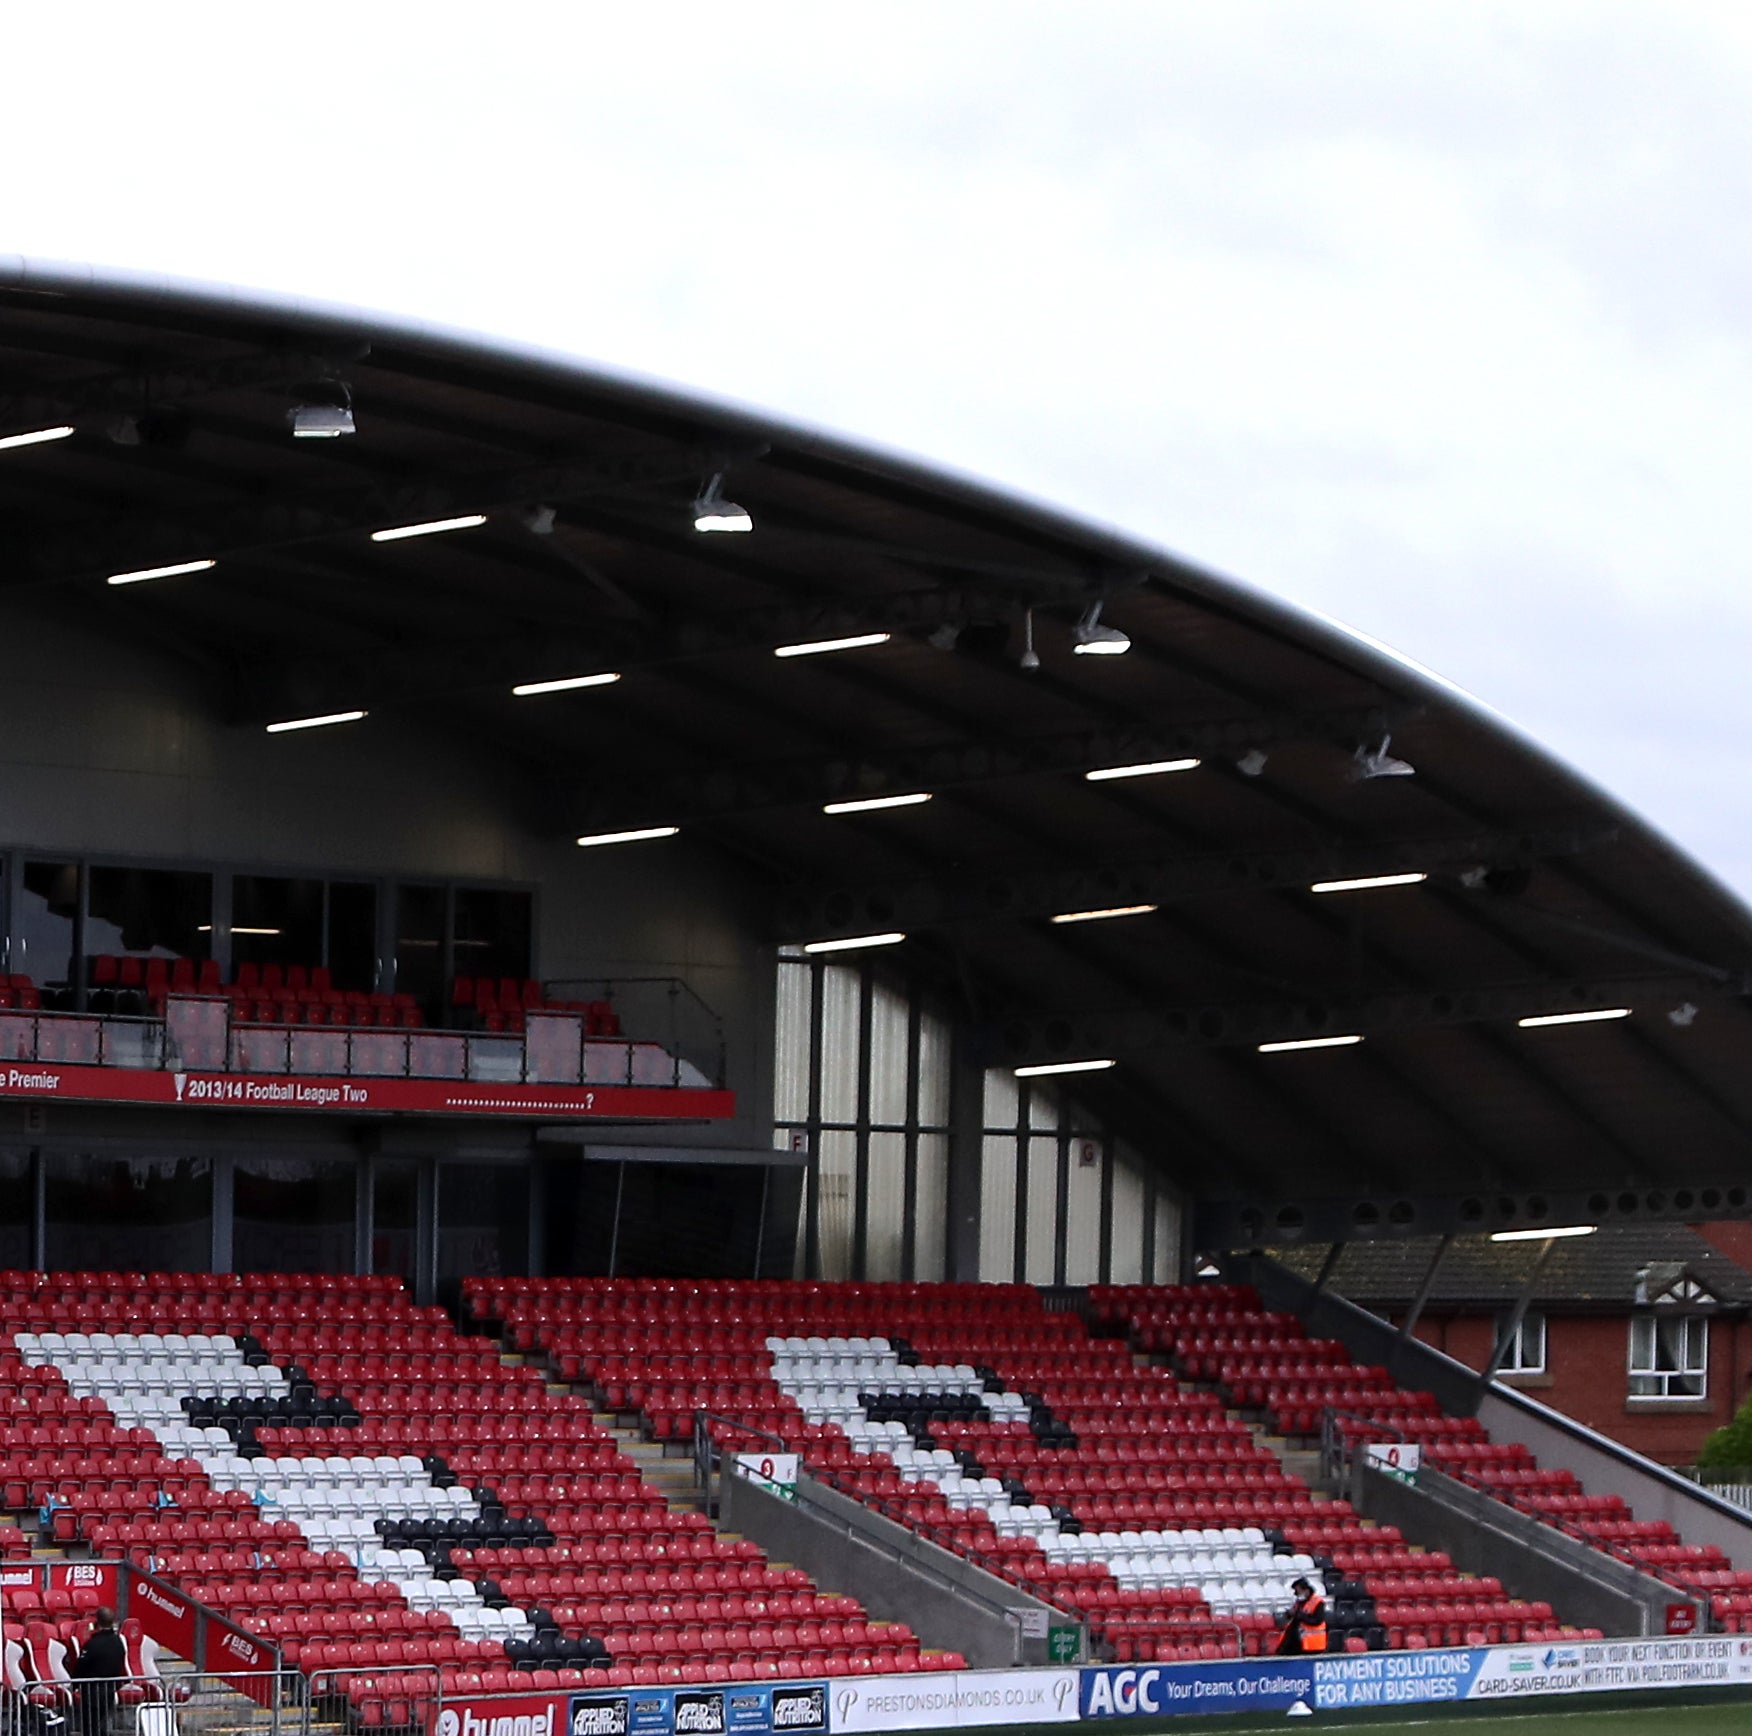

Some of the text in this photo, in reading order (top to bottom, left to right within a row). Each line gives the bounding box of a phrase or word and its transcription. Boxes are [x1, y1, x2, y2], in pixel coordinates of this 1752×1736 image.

[9, 1068, 60, 1089] Premier
[188, 1078, 368, 1104] 2013/14 Football League Two
[74, 1565, 96, 1579] BES
[1585, 1647, 1605, 1664] BOOK
[1608, 1645, 1629, 1662] YOUR
[1631, 1644, 1652, 1661] NEXT
[1654, 1642, 1693, 1659] FUNCTION
[1708, 1640, 1733, 1657] EVENT
[1315, 1653, 1471, 1682] PAYMENT SOLUTIONS
[1585, 1667, 1602, 1684] WITH
[1606, 1666, 1624, 1683] FTFC
[1088, 1669, 1161, 1716] AGC
[1167, 1675, 1311, 1699] Your Dreams, Our Challenge
[1316, 1676, 1458, 1704] FOR ANY BUSINESS
[1478, 1674, 1583, 1695] CARD-SAVER.CO.UK
[678, 1702, 709, 1717] APPLIED
[776, 1697, 812, 1712] APPLIED
[867, 1688, 1046, 1713] PRESTONSDIAMONDS.CO.UK
[576, 1707, 614, 1722] APPLIED
[677, 1713, 722, 1731] NUTRITION
[774, 1707, 822, 1725] NUTRITION
[575, 1718, 625, 1736] NUTRITION
